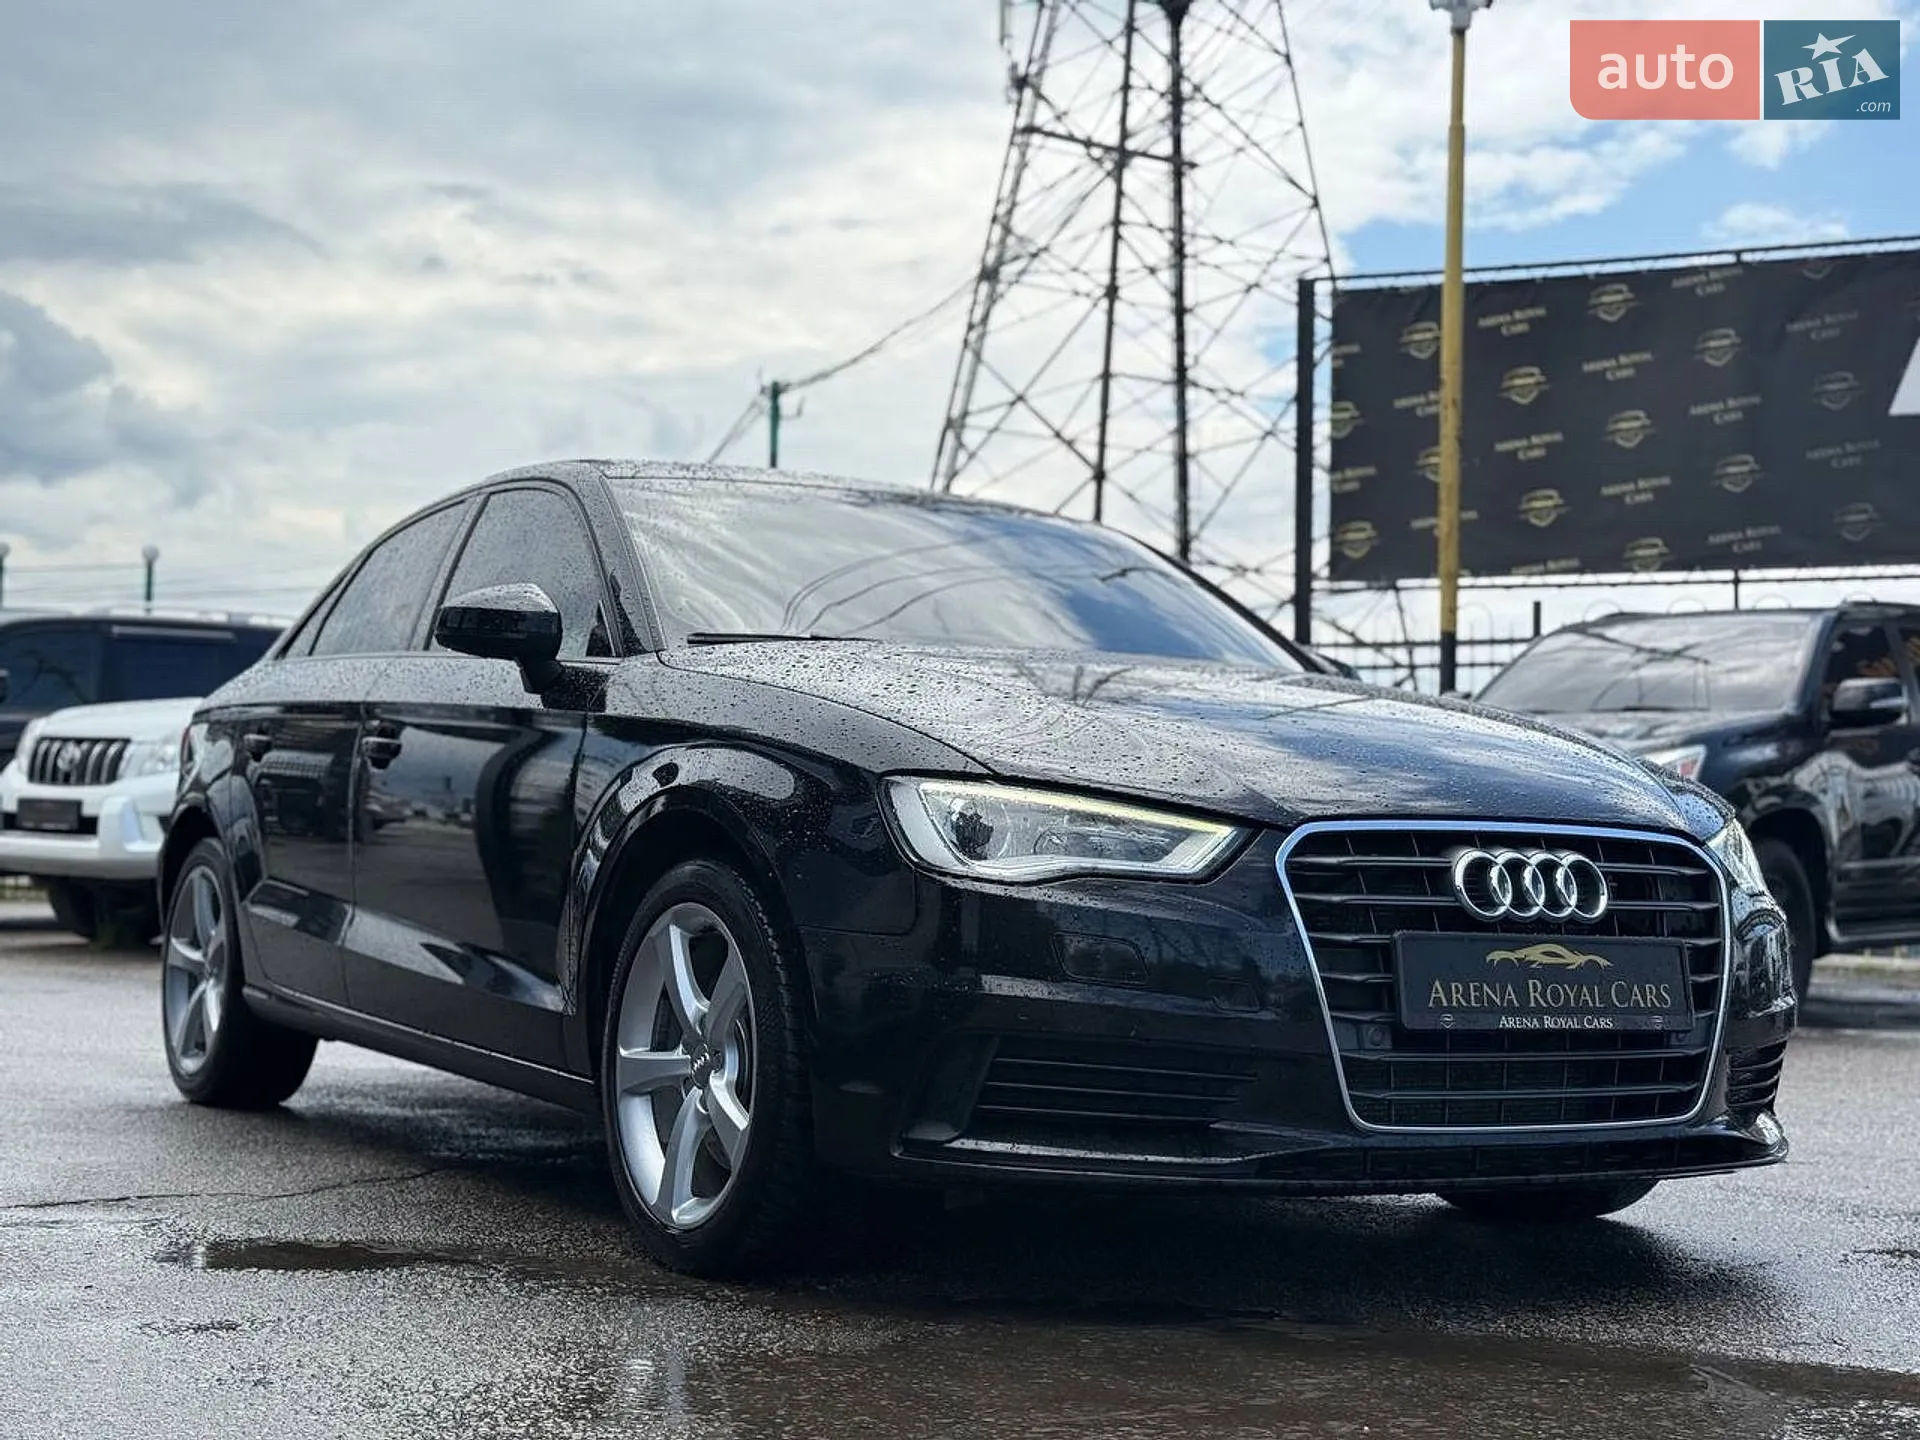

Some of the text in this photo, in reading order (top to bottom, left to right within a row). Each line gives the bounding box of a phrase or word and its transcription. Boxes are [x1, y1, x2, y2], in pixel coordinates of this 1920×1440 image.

[1428, 979, 1671, 1009] ARENA ROYAL CARS
[1499, 1015, 1614, 1029] ARENA ROYAL CARS
